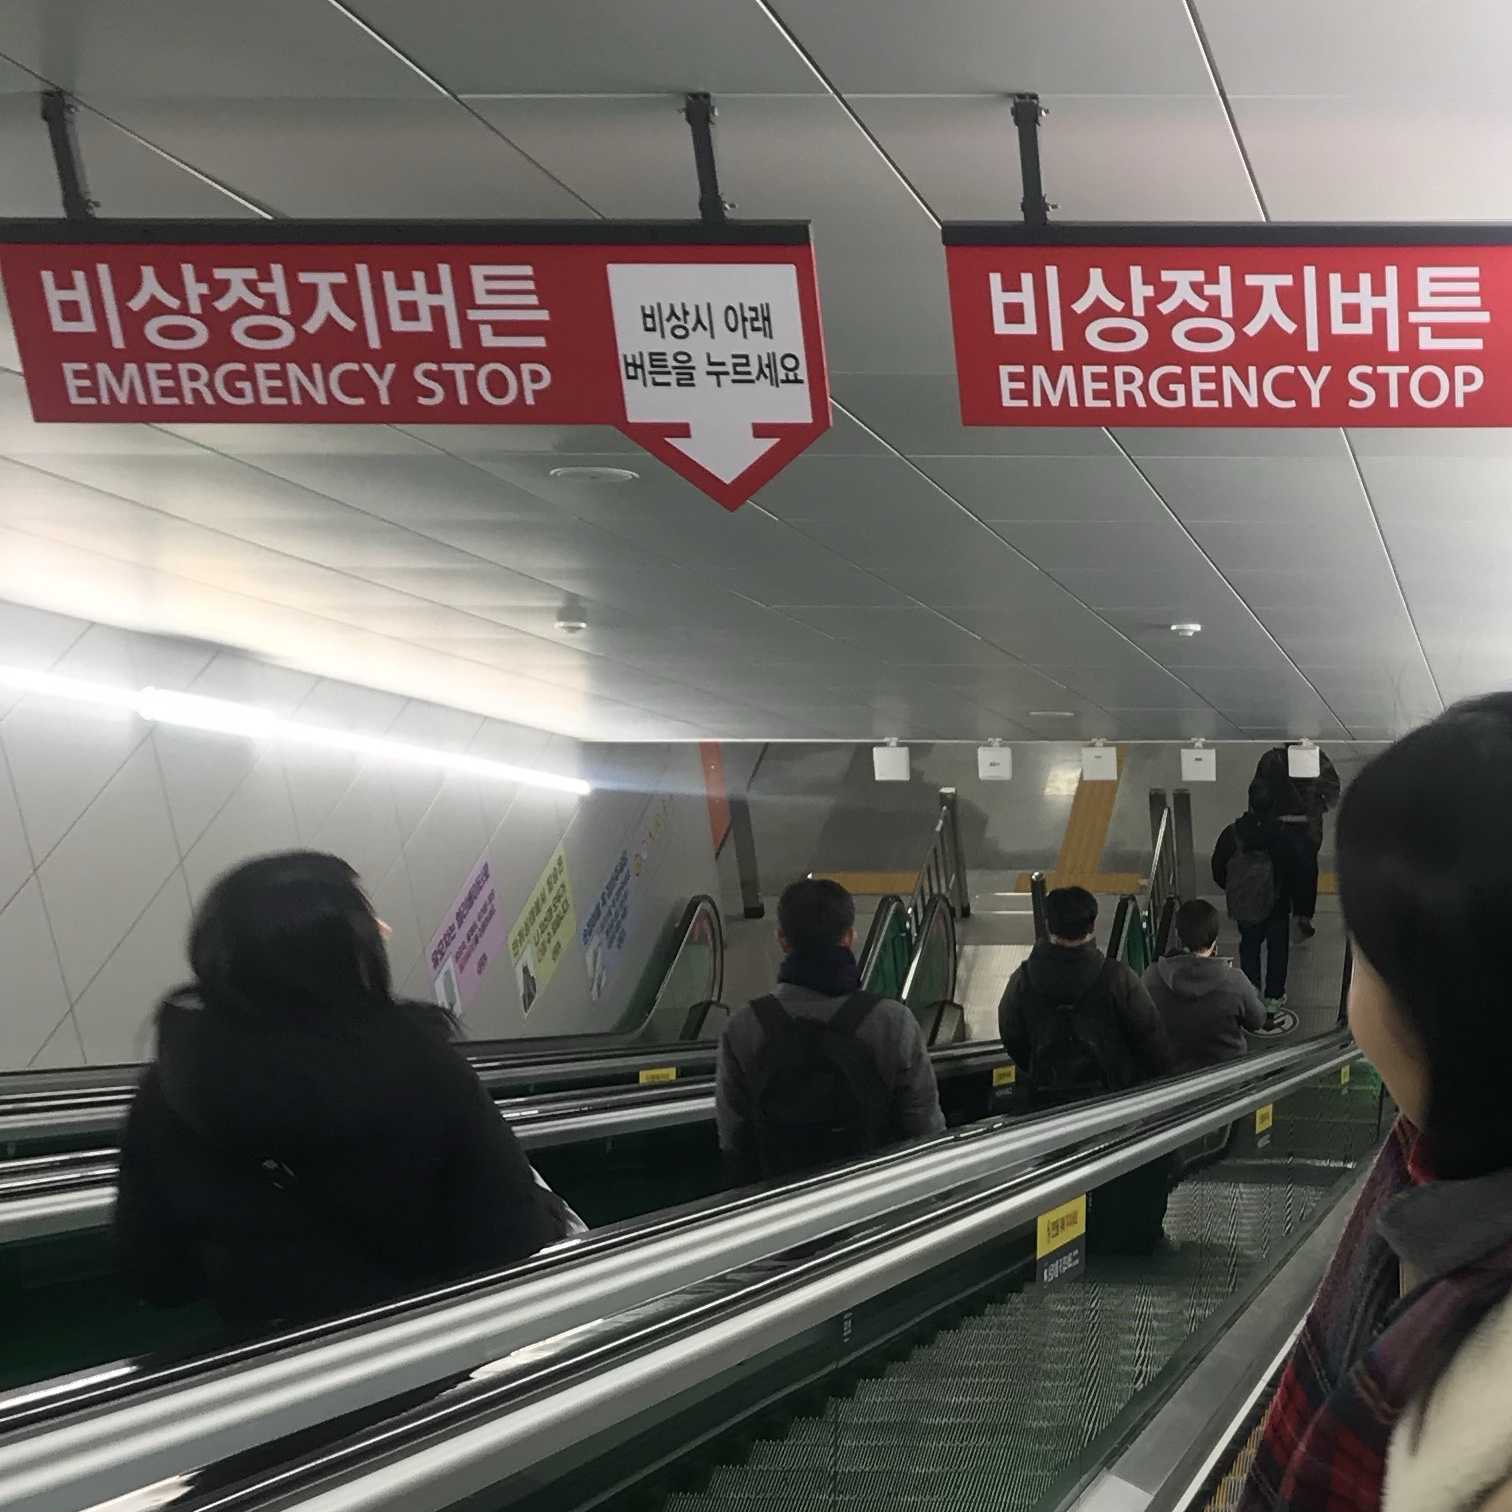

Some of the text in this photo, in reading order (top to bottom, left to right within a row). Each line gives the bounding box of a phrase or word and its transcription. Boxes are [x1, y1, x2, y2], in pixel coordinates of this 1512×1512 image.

[41, 263, 550, 350] 비상정지버튼
[641, 302, 774, 340] 비상시 아래
[989, 265, 1491, 353] 비상정지버튼
[62, 363, 551, 405] EMERGENCY STOP
[623, 351, 804, 389] 버튼을 누르세요
[999, 365, 1484, 408] EMERGENCY STOP
